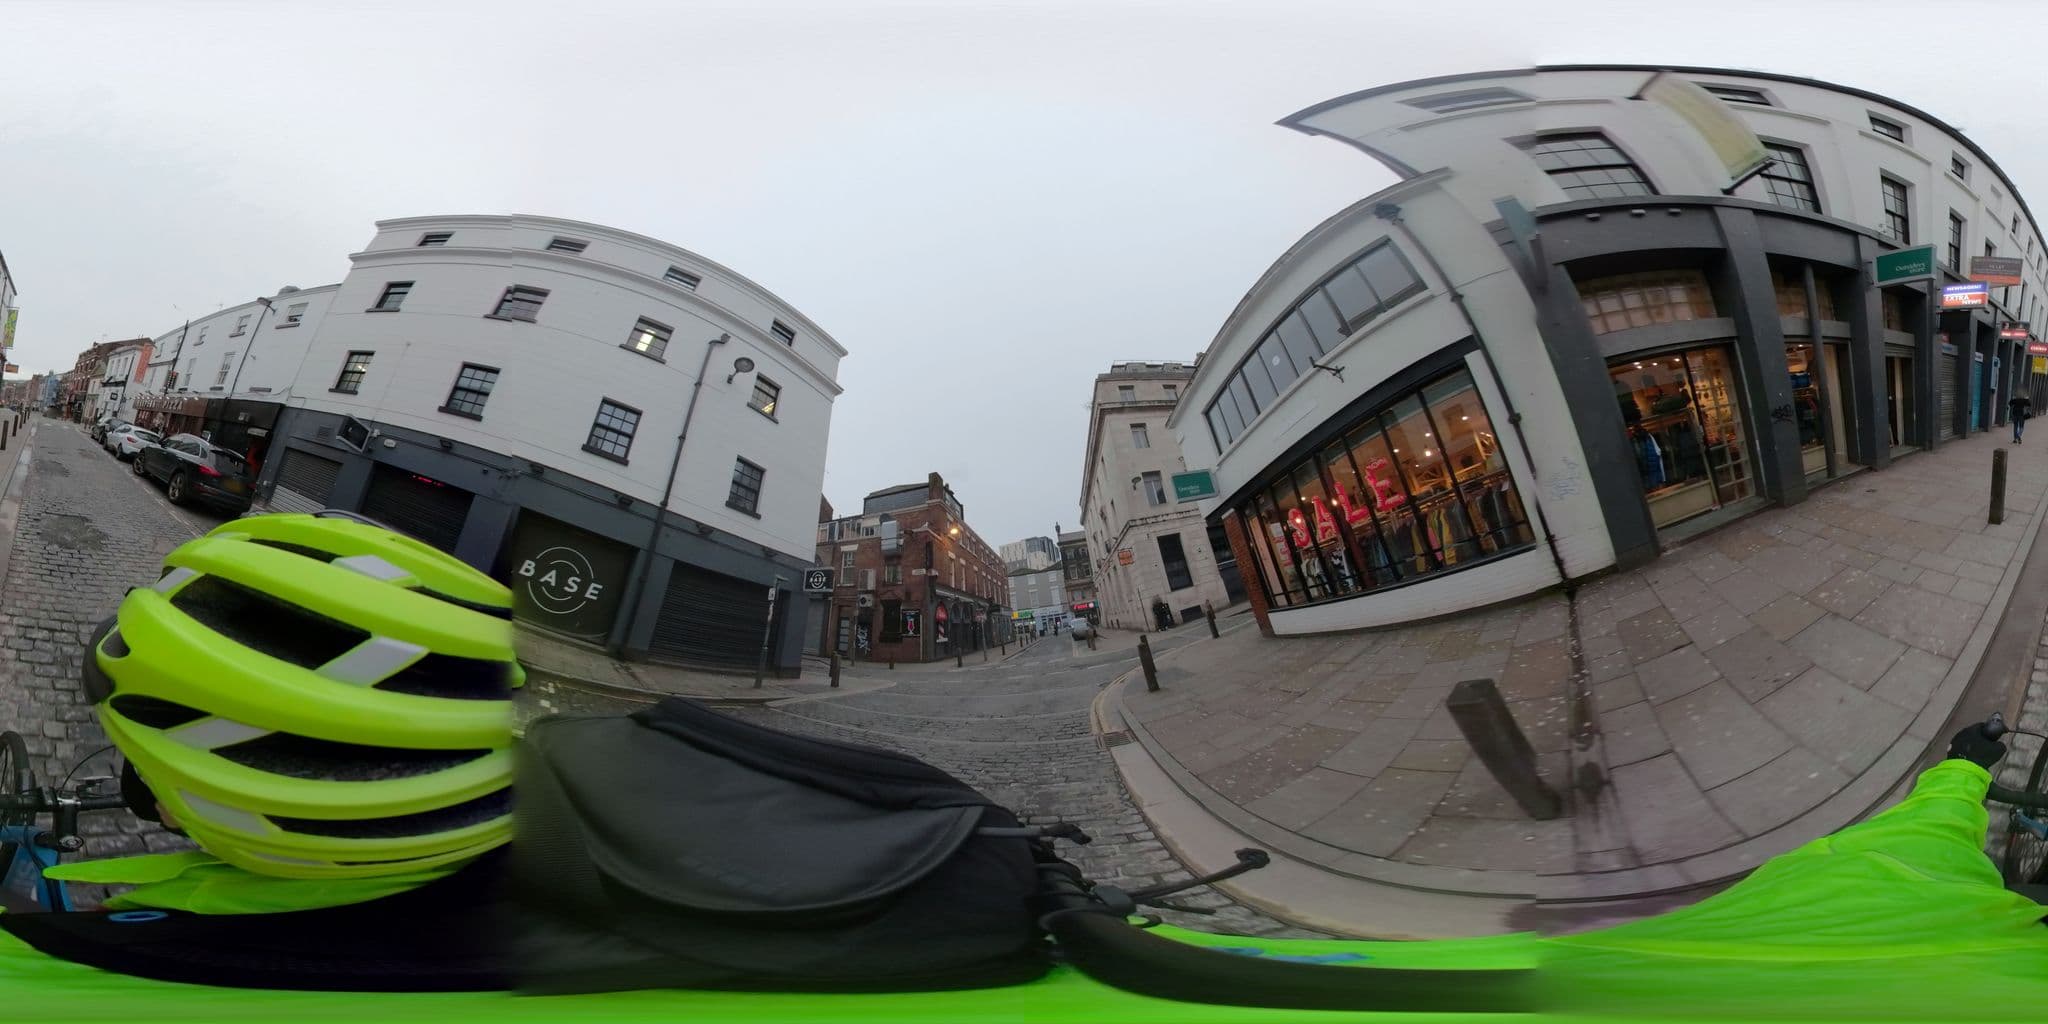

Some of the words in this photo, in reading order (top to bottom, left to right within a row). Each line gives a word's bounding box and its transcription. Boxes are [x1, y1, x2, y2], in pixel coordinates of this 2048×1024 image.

[1947, 284, 1982, 292] NEWSAGENT
[1287, 457, 1407, 548] SALE
[518, 559, 603, 600] BASE
